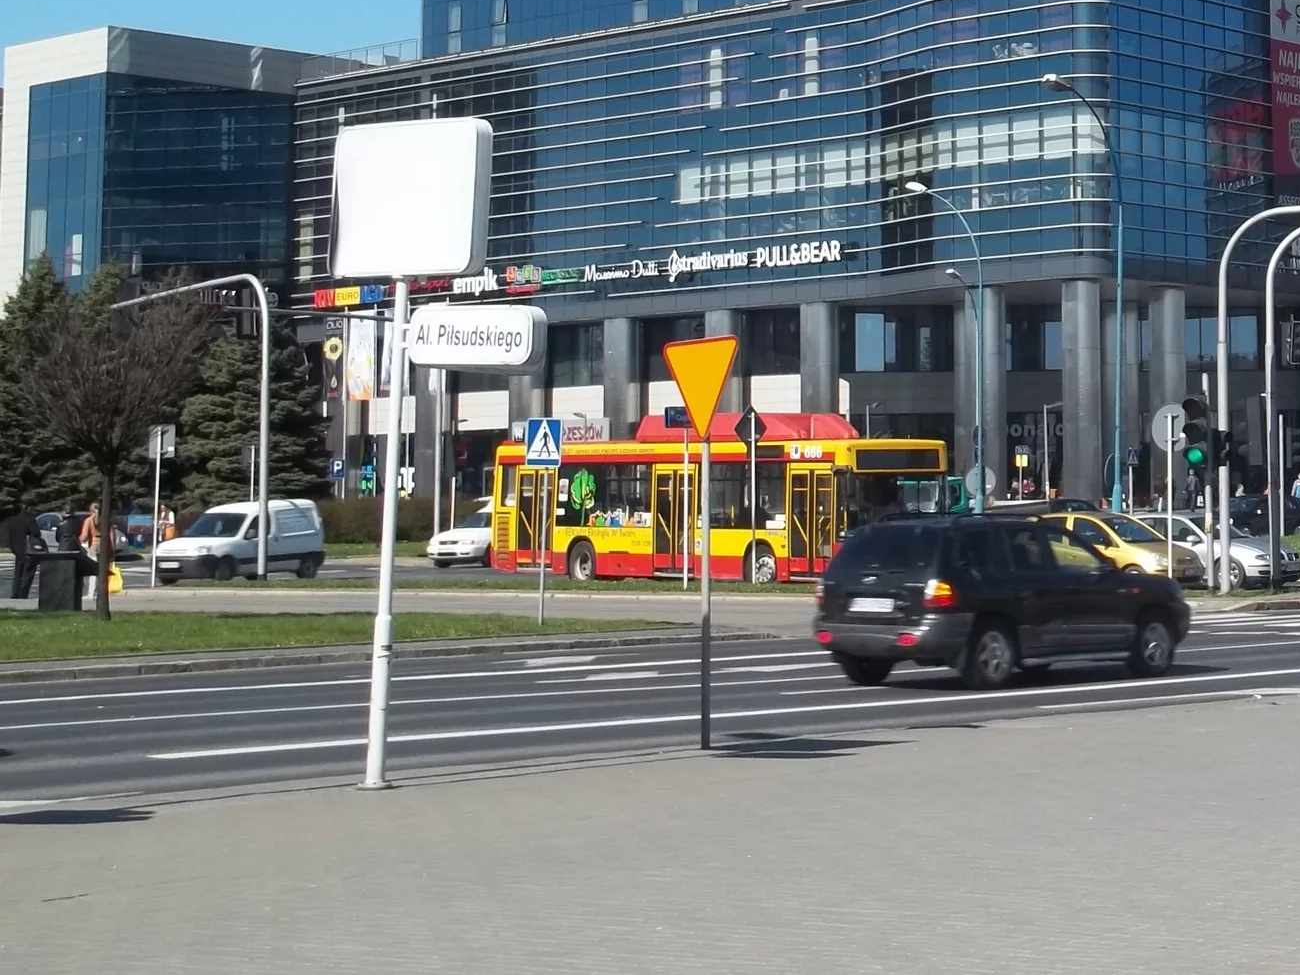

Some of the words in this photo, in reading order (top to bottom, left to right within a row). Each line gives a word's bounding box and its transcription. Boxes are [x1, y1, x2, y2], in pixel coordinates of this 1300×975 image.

[757, 240, 842, 268] PULL&BEAR
[453, 267, 499, 296] empik
[583, 264, 630, 283] Massimo
[631, 259, 660, 278] Dutti
[337, 292, 359, 301] EURO
[416, 324, 432, 345] Al.
[437, 324, 523, 353] Piłsudskiego
[333, 460, 343, 474] P
